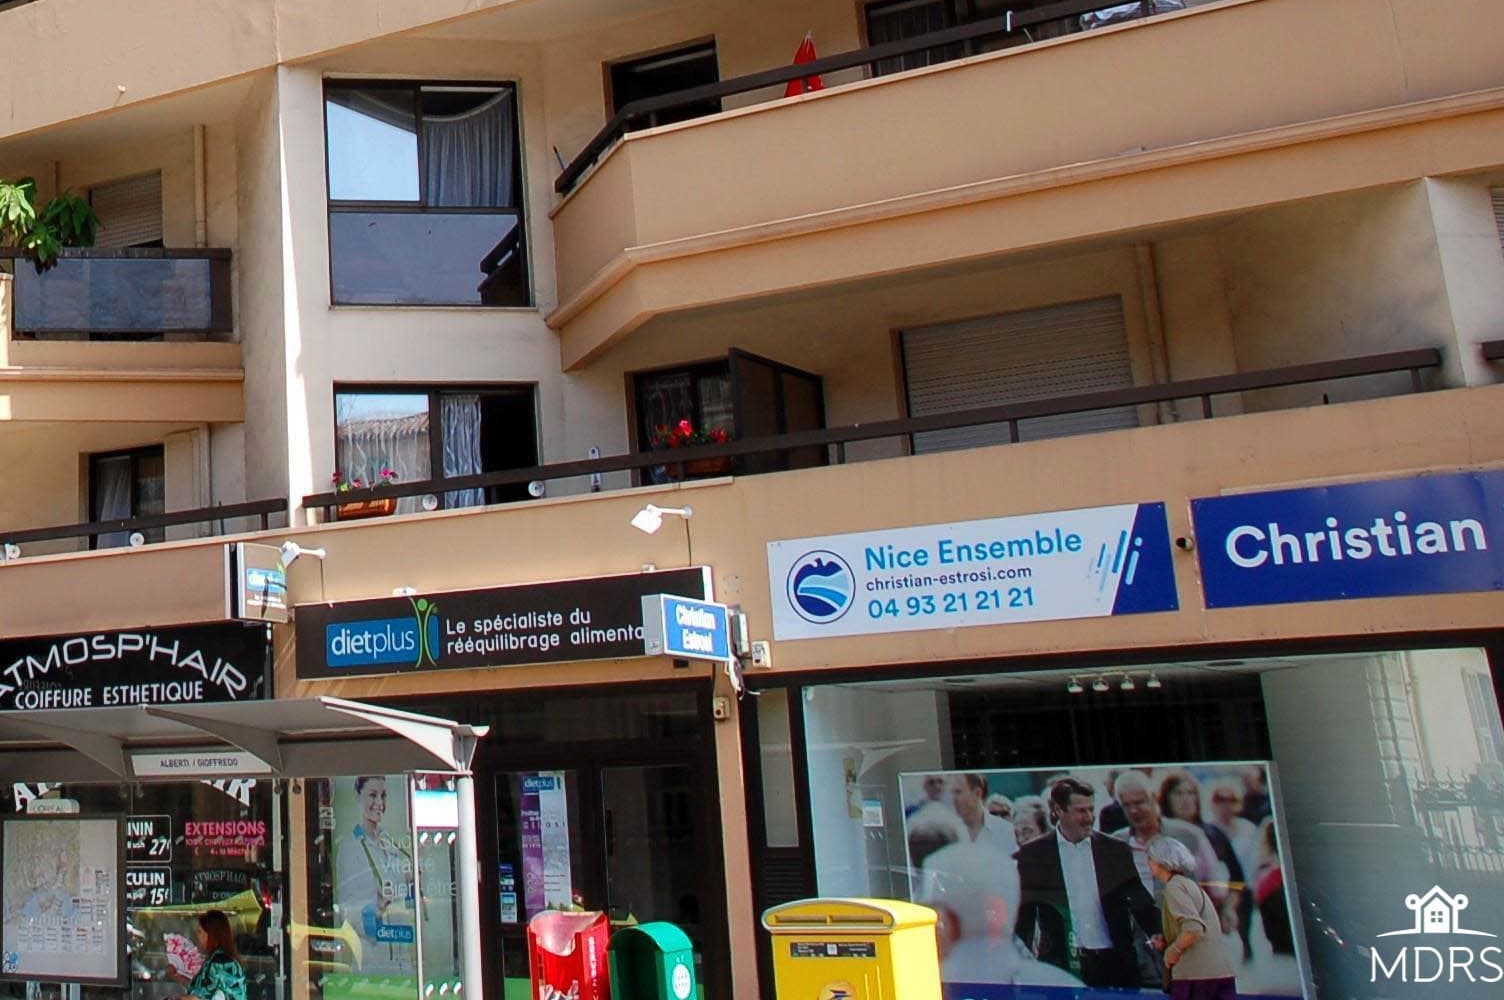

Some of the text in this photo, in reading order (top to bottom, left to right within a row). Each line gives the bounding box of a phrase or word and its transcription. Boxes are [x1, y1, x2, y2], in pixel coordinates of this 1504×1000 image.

[864, 527, 1082, 571] Nice Ensemble
[1225, 510, 1487, 569] Christian
[866, 565, 1033, 592] christian-estrosi.com
[868, 585, 1034, 619] 04 93 21 21 21
[446, 607, 591, 635] Le spécialiste du
[331, 623, 416, 659] dietplus
[447, 631, 561, 655] rééquilibrage
[15, 680, 204, 710] COIFFURE ESTHETIQUE
[184, 821, 266, 836] EXTENSIONS
